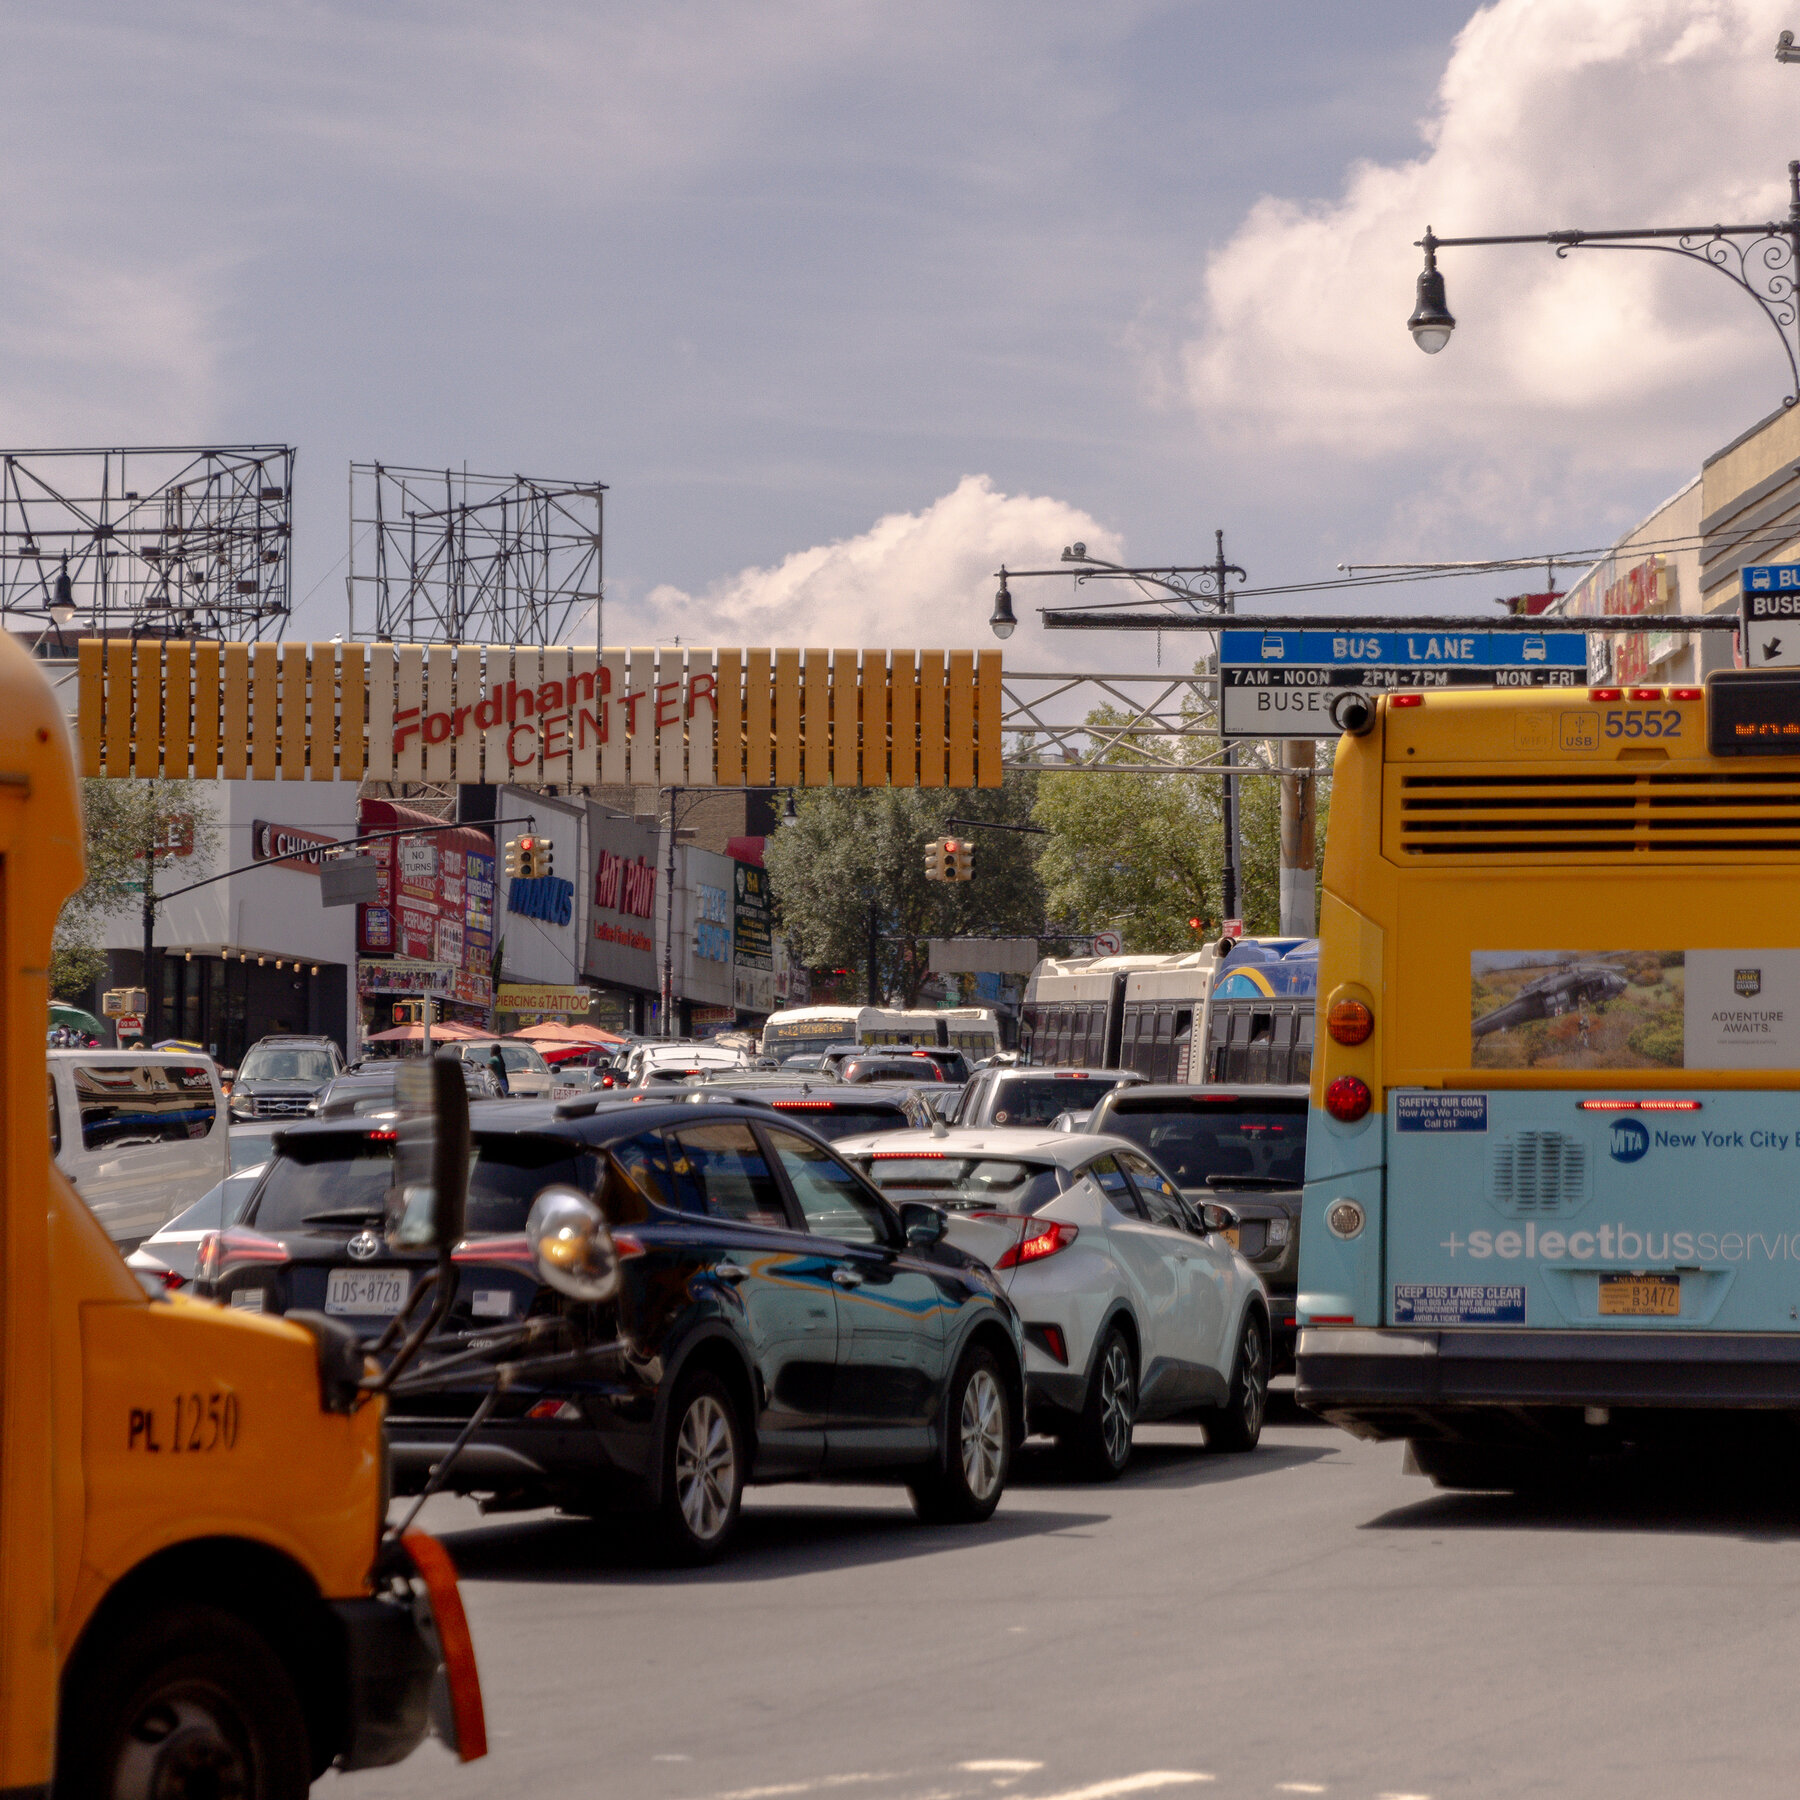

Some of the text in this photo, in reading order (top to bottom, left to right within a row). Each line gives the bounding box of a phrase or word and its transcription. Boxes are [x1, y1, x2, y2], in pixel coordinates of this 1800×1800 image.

[1332, 638, 1475, 660] BUS LANE
[393, 666, 611, 753] Fordham
[506, 673, 718, 767] CENTER
[1605, 710, 1682, 738] 5552
[1566, 736, 1593, 746] USB
[411, 850, 425, 860] NO
[405, 862, 432, 872] TURNS
[403, 909, 433, 933] PERFUMES
[545, 995, 589, 1010] TATTOO
[1711, 1012, 1784, 1022] ADVENTURE
[1723, 1023, 1771, 1032] AWAITS.
[1399, 1097, 1484, 1107] SAFETY'S OUR GOAL
[1399, 1108, 1483, 1118] How Are We Doing?
[1424, 1119, 1457, 1128] Call 511
[1609, 1127, 1643, 1155] MTA
[1655, 1131, 1696, 1148] New
[1701, 1131, 1744, 1148] York
[1749, 1130, 1789, 1151] City
[1397, 1287, 1520, 1299] KEEP BUS LANES CLEAR
[467, 1339, 493, 1348] AWD
[128, 1392, 239, 1452] PL 1250
